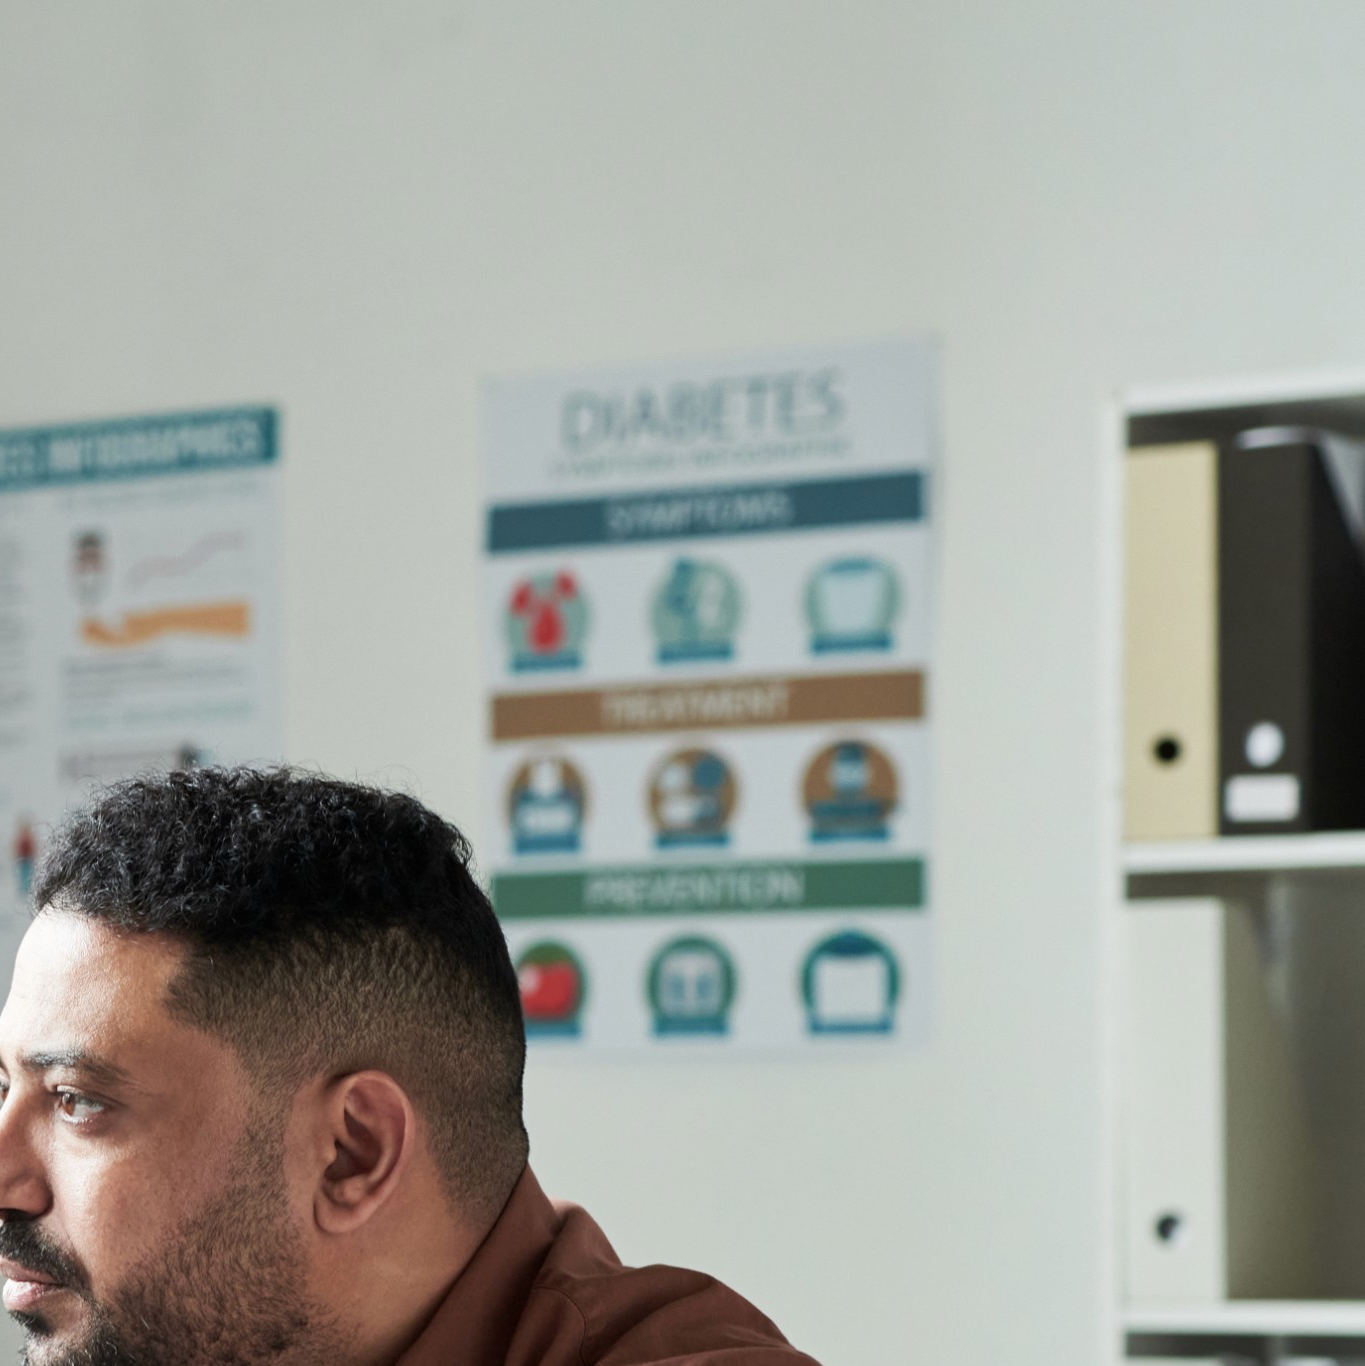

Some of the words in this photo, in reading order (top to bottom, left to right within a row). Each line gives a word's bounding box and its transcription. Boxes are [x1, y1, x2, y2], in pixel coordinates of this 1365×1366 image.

[562, 368, 845, 449] DIABETES
[607, 491, 793, 535] SYMPTOMS
[604, 685, 787, 725] TREATMENT
[586, 870, 803, 911] PREVENTION
